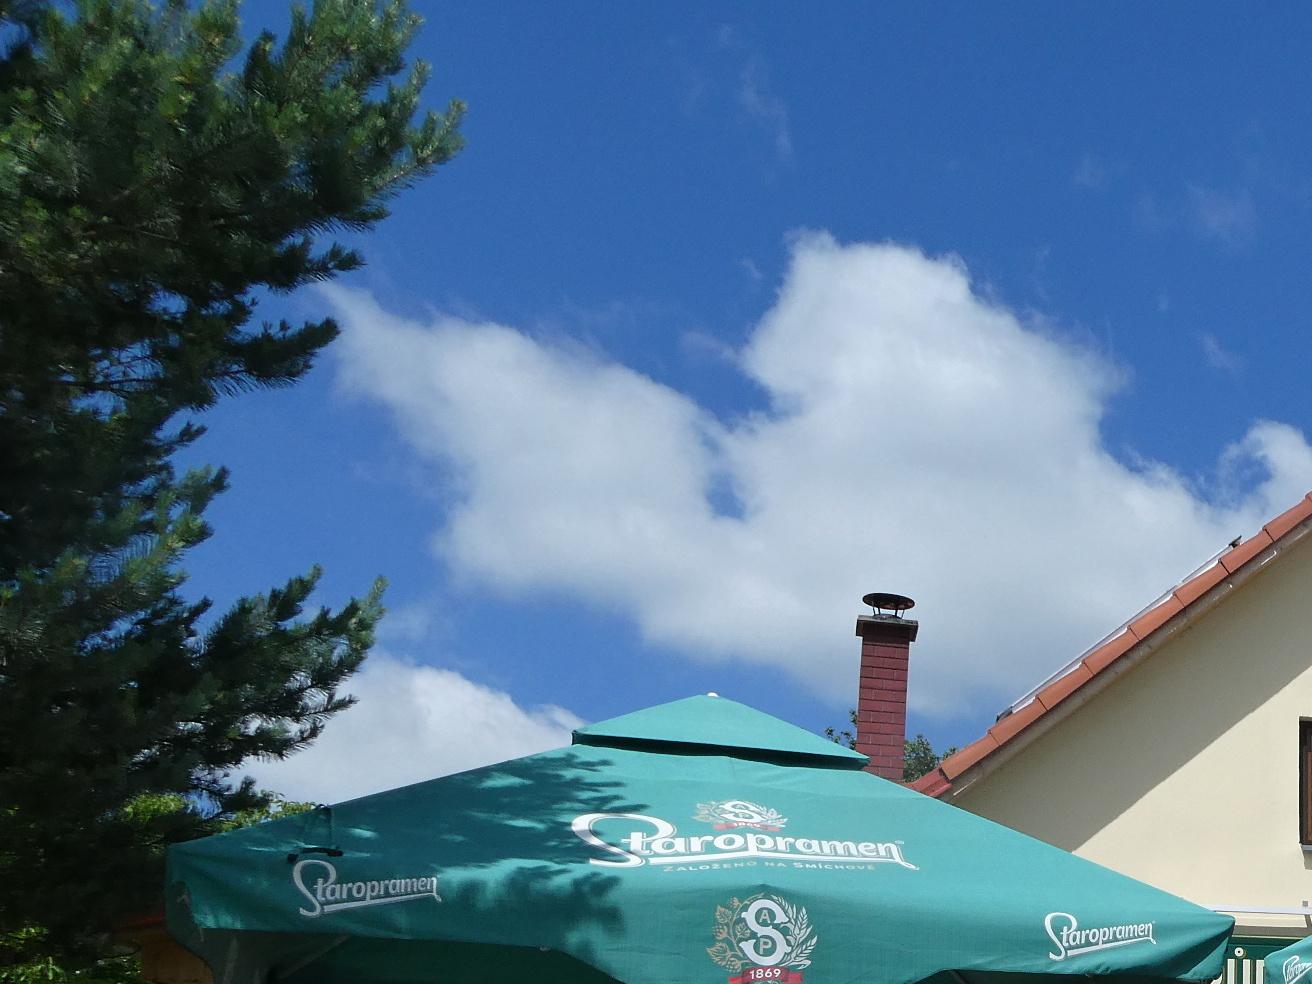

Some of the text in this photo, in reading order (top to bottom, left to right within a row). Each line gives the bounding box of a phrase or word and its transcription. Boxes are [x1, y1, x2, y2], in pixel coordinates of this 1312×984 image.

[571, 812, 919, 870] Staropramen
[293, 859, 442, 917] Staropramen
[1044, 912, 1157, 960] Staropramen
[749, 967, 782, 980] 1869
